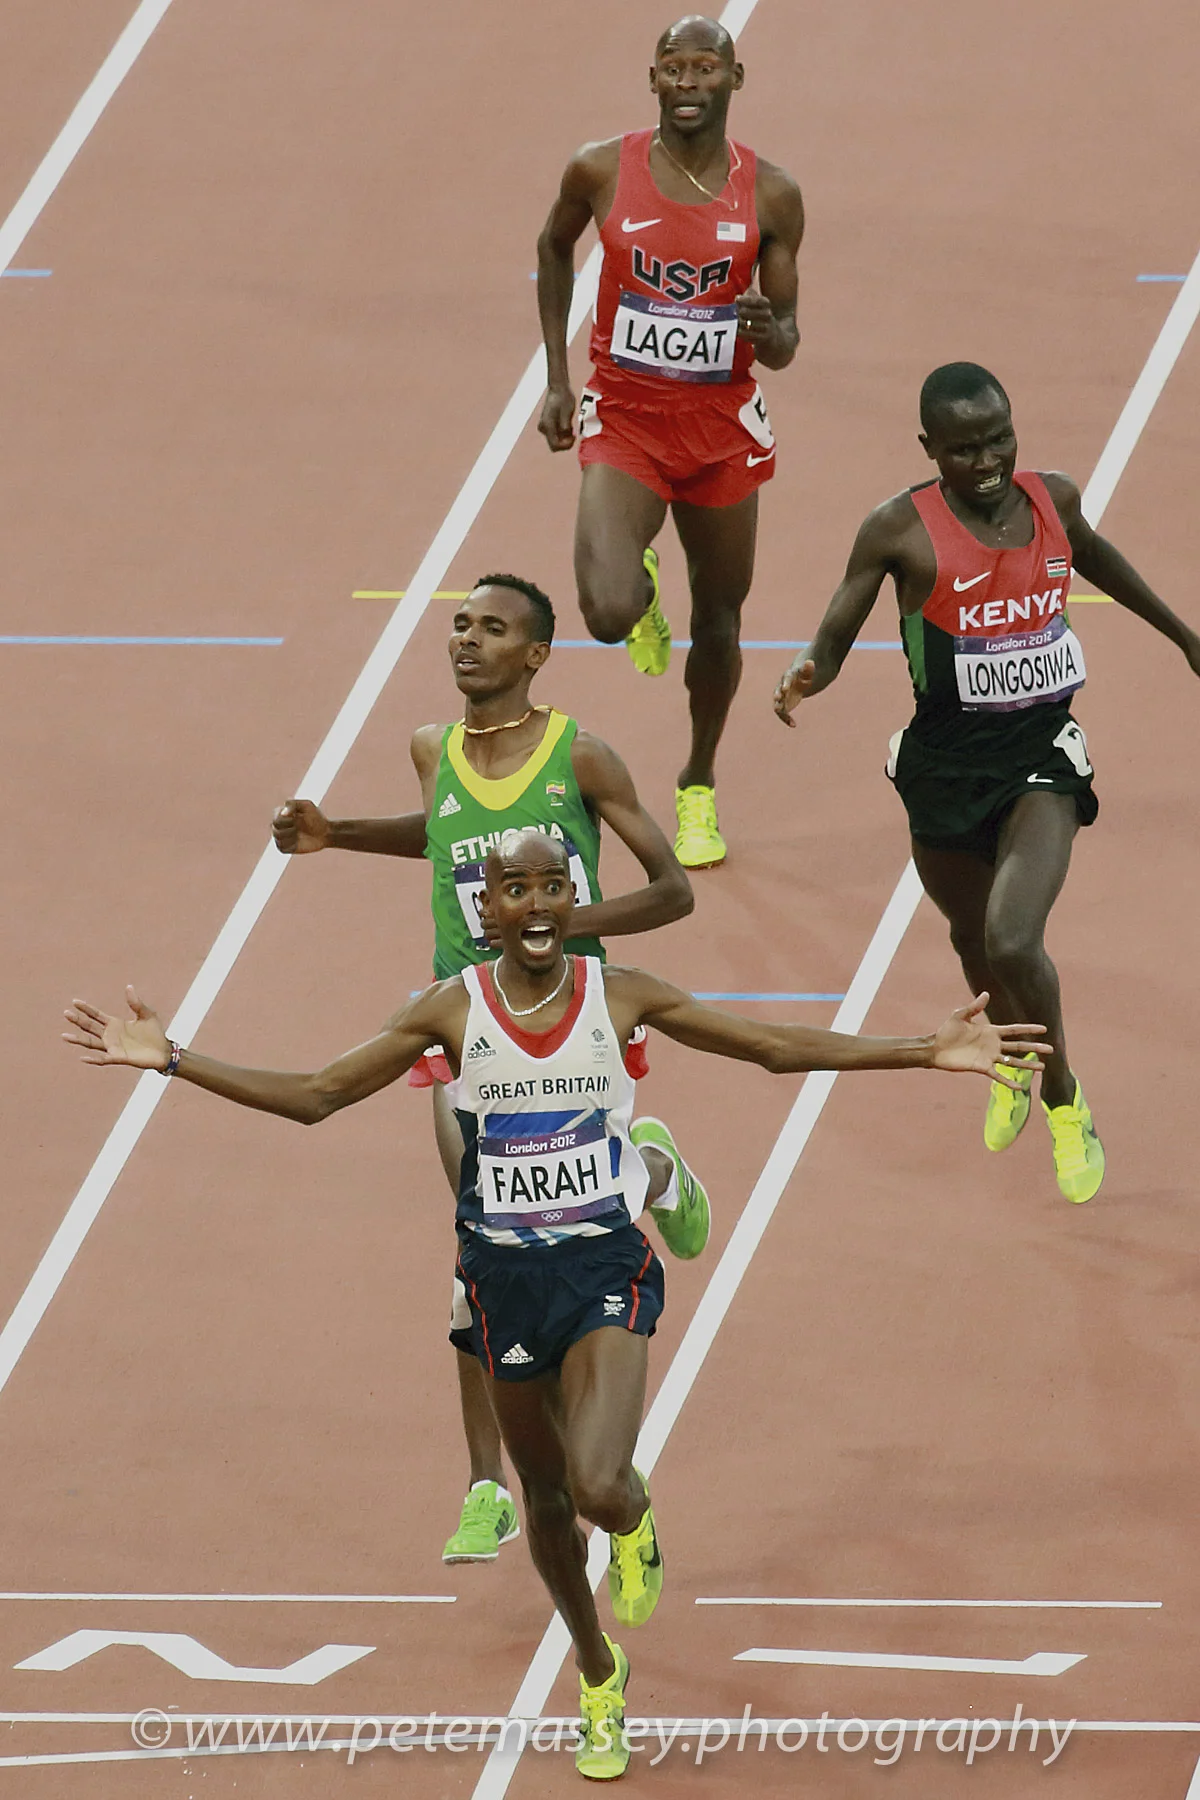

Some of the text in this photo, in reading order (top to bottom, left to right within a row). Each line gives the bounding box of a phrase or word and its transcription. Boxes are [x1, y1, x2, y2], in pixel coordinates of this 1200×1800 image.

[632, 245, 733, 303] USA
[648, 303, 715, 319] London 2012
[625, 319, 727, 364] LAGAT
[959, 588, 1063, 631] KENYA
[986, 631, 1053, 651] London 2012
[967, 643, 1078, 697] LONGOSIWA
[467, 1049, 497, 1059] adidas
[478, 1075, 611, 1100] GREAT BRITAIN
[505, 1134, 576, 1154] London 2012
[492, 1154, 599, 1203] FARAH
